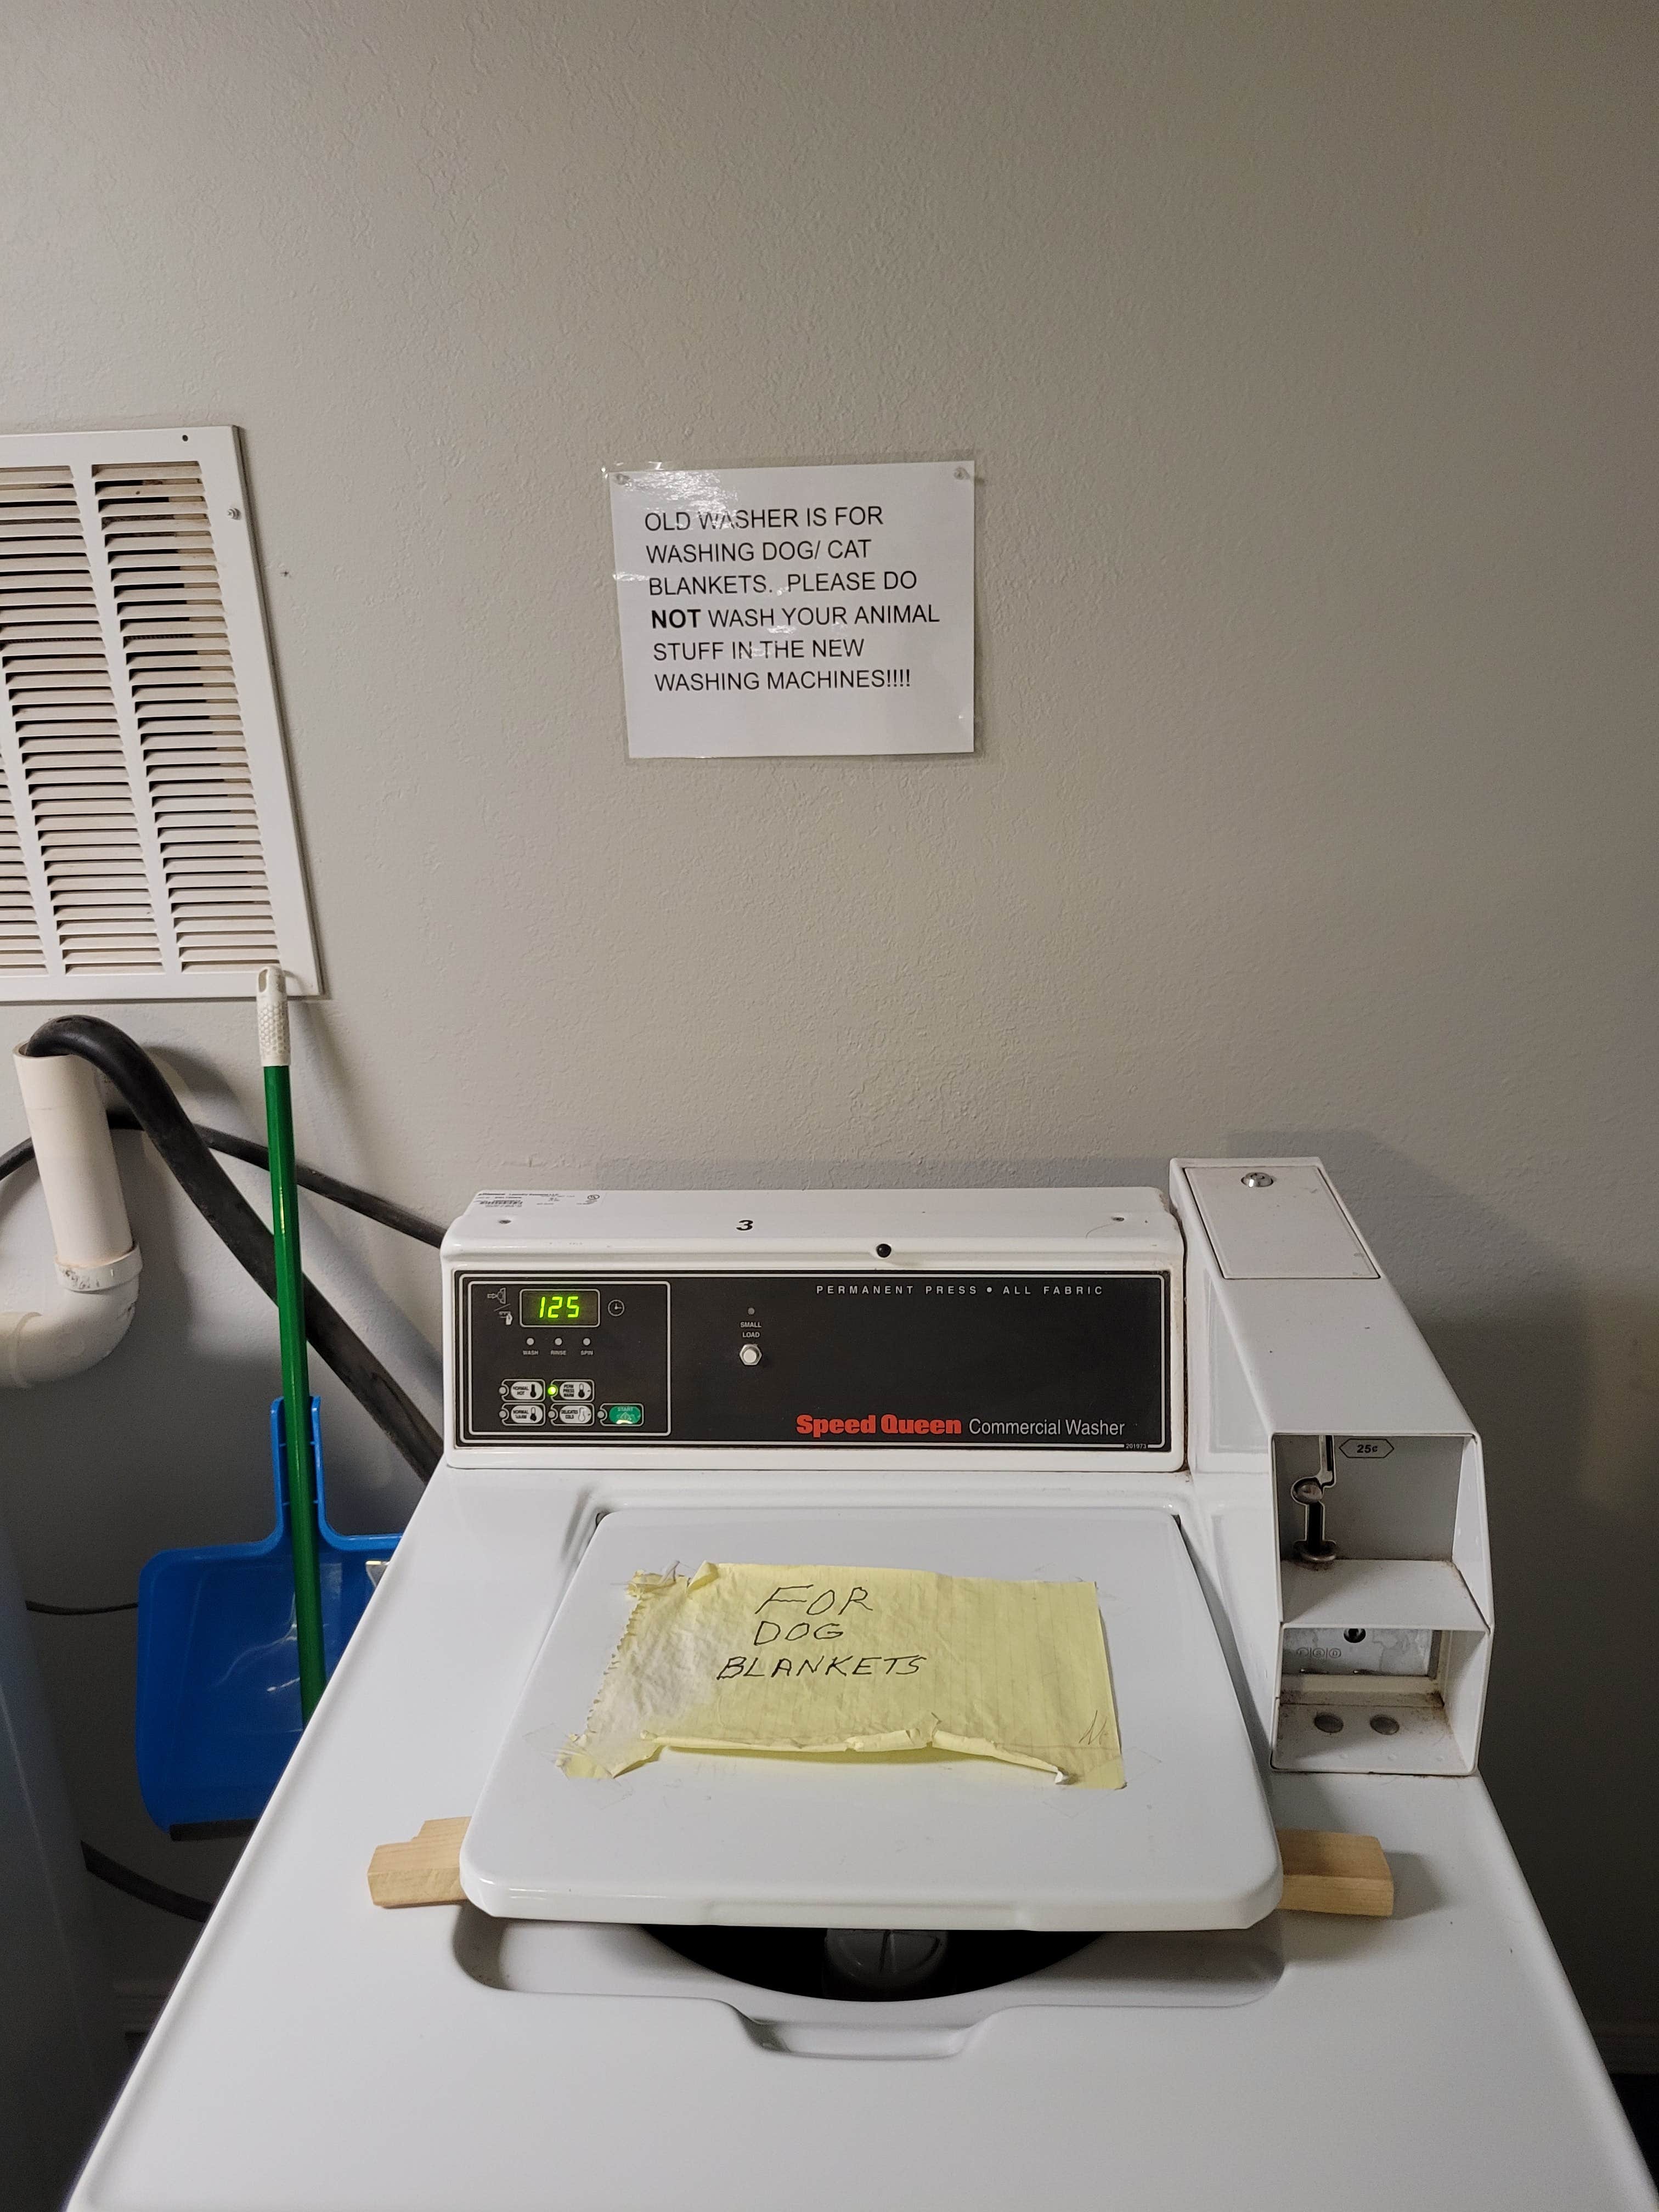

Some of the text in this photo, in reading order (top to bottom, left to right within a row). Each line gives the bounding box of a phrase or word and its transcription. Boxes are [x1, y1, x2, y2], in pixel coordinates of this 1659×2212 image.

[645, 505, 884, 531] OLD WASHER IS FOR
[646, 539, 872, 563] WASHING DOG/ CAT
[649, 570, 917, 595] BLANKETS. PLEASE DO
[651, 604, 940, 629] NOT WASH YOUR ANIMAL
[653, 638, 865, 661] STUFF IN THE NEW
[654, 669, 911, 692] WASHING MACHINES!!!!
[736, 1220, 754, 1231] 3
[816, 1285, 1103, 1295] PERMANENT PRESS ALL FABRIC
[539, 1296, 580, 1318] 125
[796, 1414, 1125, 1438] Speed Queen Commercial Washer
[754, 1584, 874, 1616] FOR
[753, 1620, 844, 1646] DOG
[716, 1655, 927, 1680] BLANKETS
